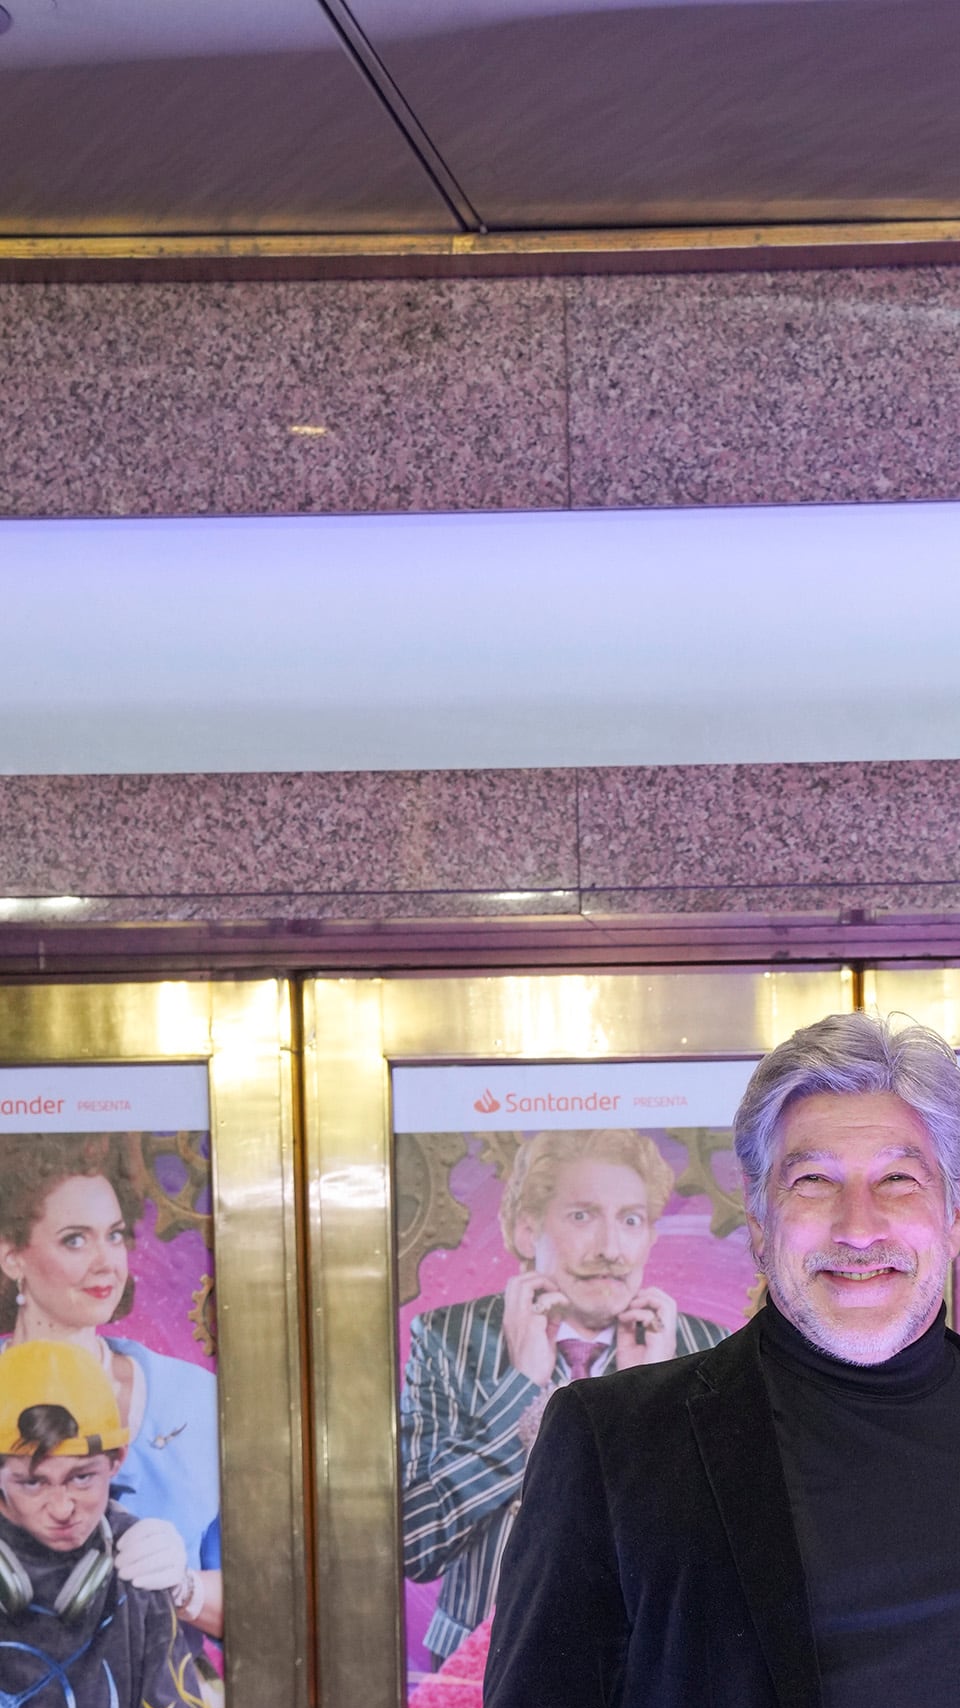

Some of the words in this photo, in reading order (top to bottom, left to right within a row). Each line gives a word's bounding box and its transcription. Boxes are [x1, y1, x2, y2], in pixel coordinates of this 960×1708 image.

[0, 1096, 65, 1116] ander
[77, 1100, 132, 1112] PRESENTA
[505, 1092, 621, 1113] Santander
[633, 1096, 688, 1108] PRESENTA
